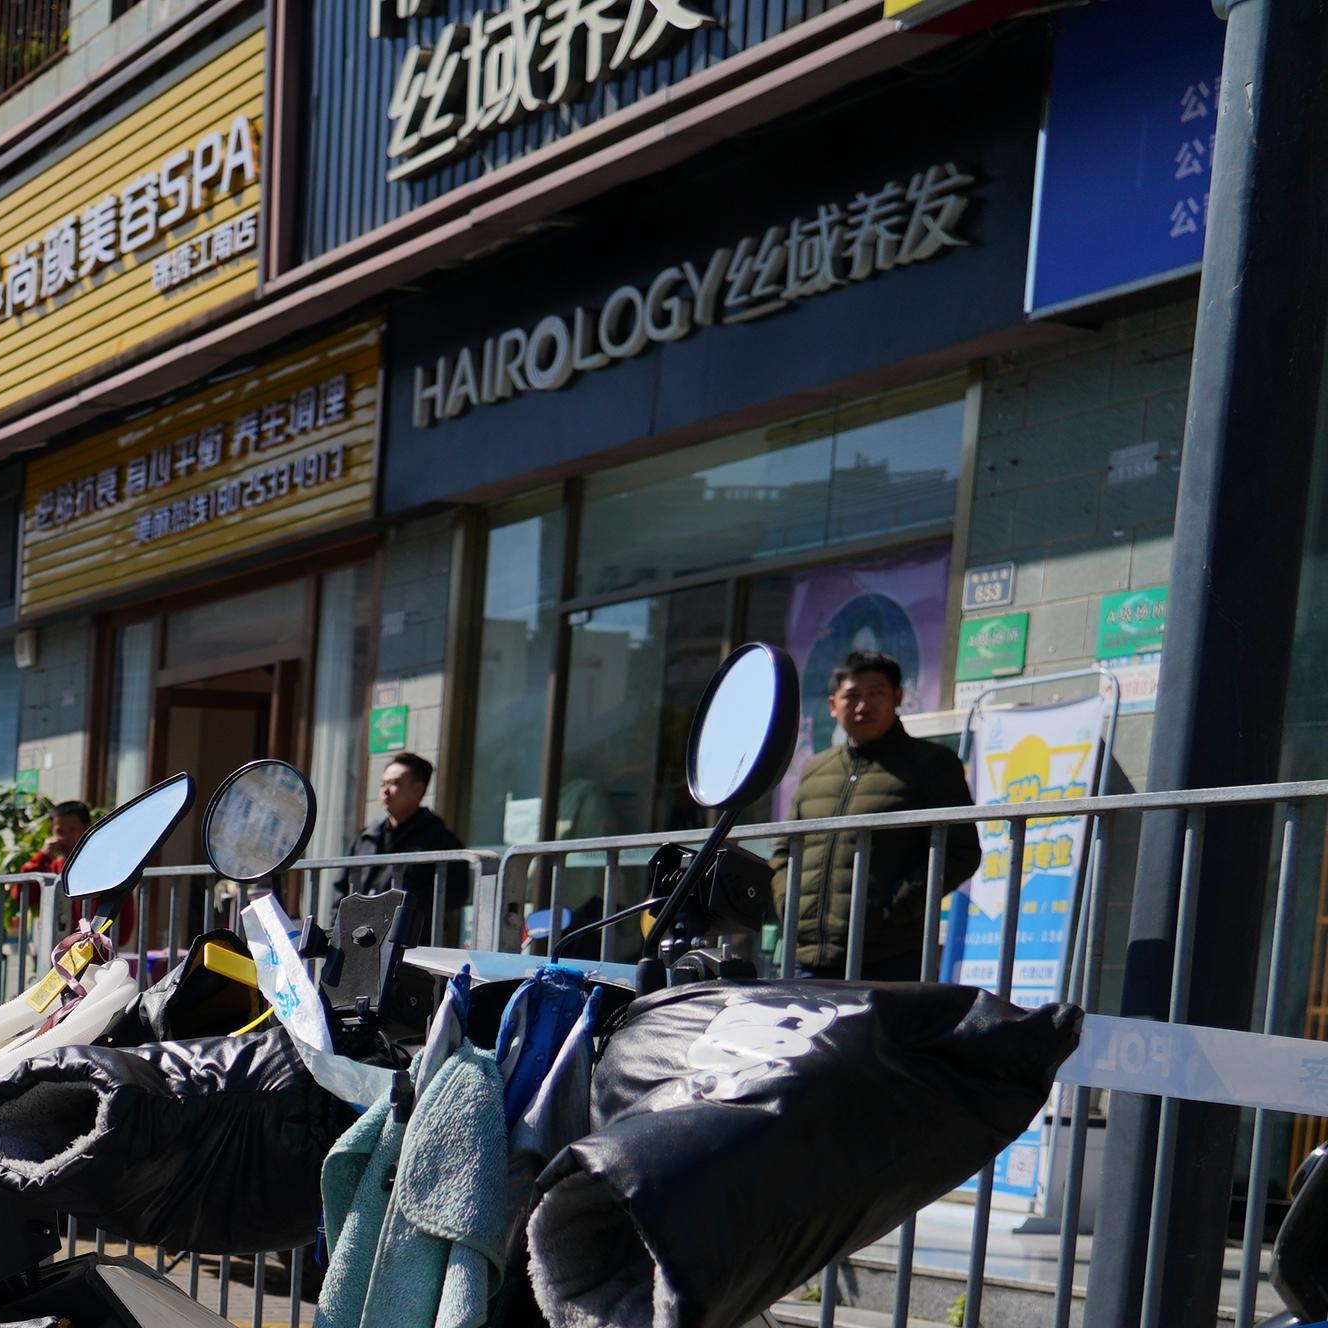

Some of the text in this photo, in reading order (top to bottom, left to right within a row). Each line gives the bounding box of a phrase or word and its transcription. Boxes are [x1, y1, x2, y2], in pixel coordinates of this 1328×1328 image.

[1181, 76, 1220, 122] 公
[1176, 134, 1215, 179] 公
[1170, 193, 1208, 238] 公
[413, 162, 976, 427] HAIROLOGY 丝域养发
